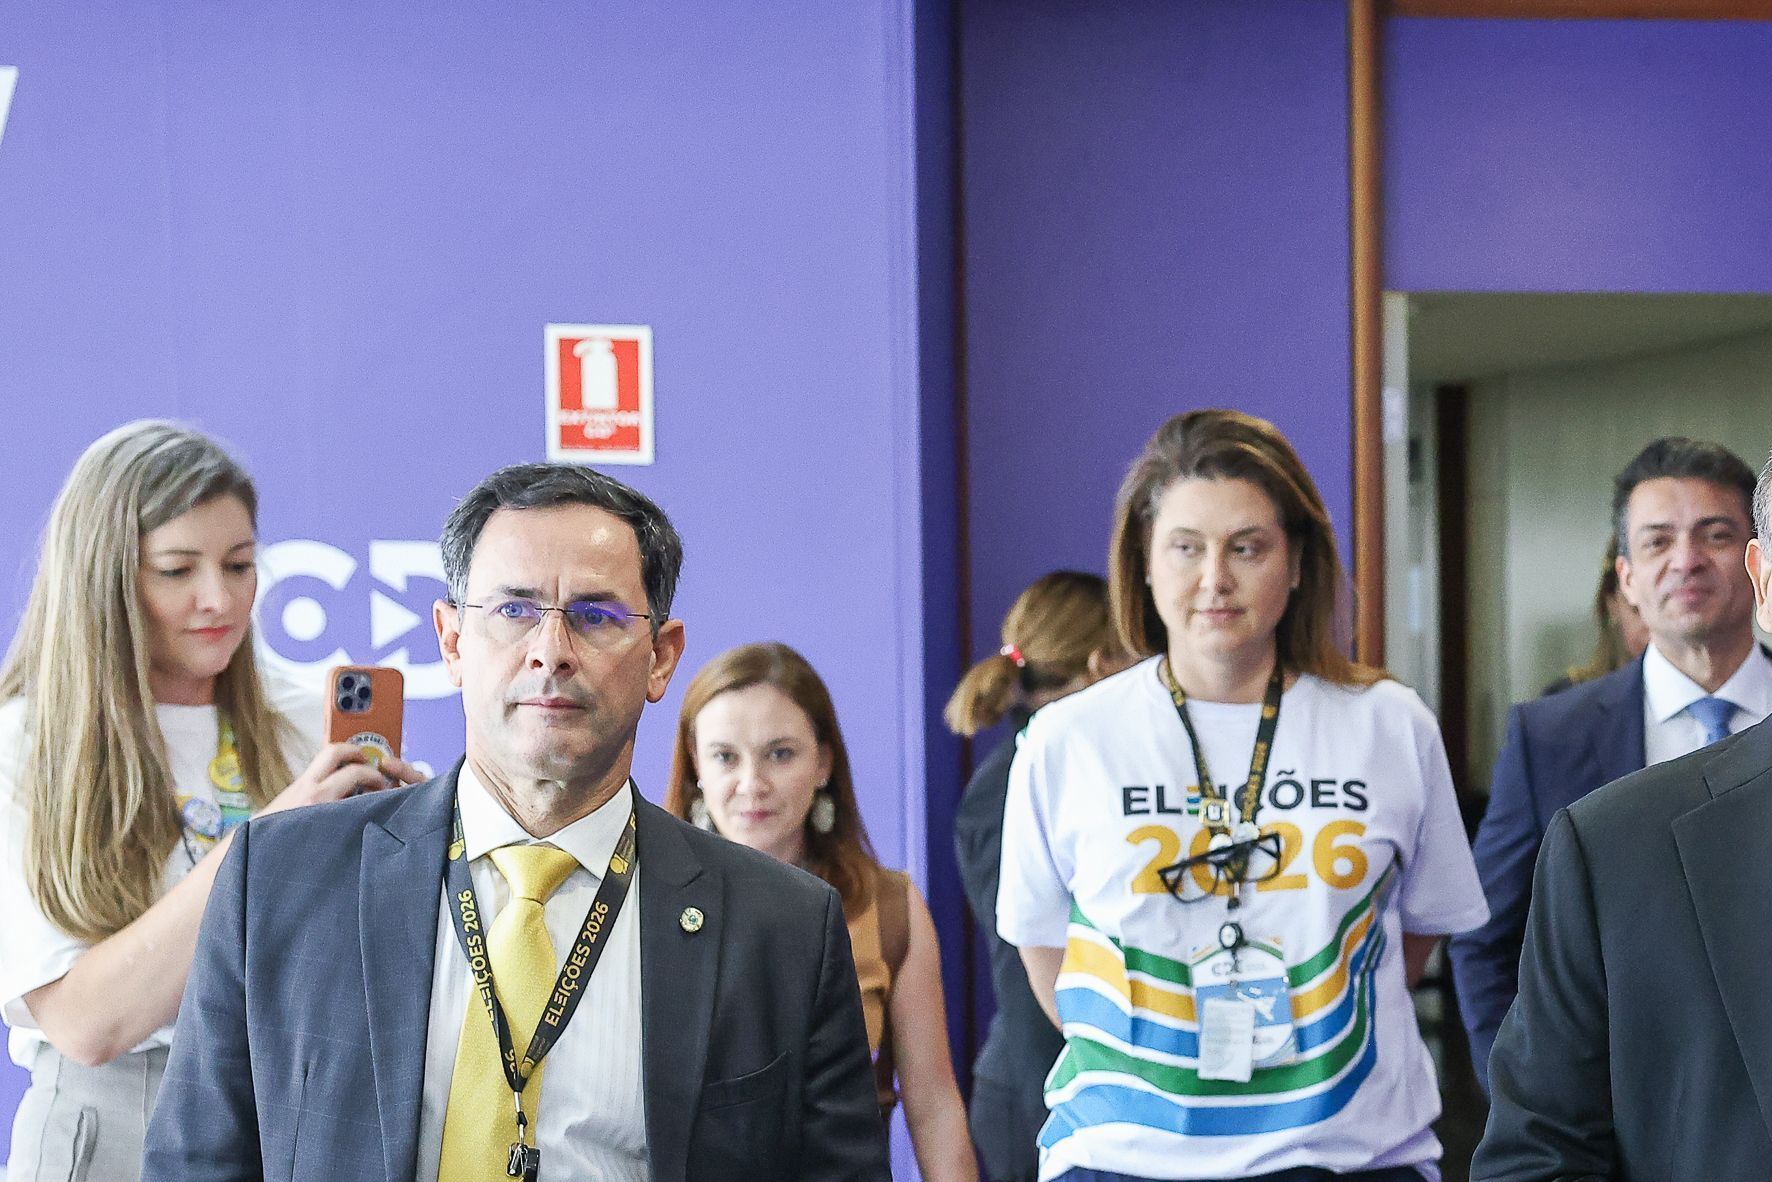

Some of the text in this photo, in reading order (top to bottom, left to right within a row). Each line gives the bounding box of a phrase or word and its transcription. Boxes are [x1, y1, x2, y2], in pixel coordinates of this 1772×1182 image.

[457, 889, 479, 932] 2026
[544, 901, 609, 1027] ELEIÇÕES 2026
